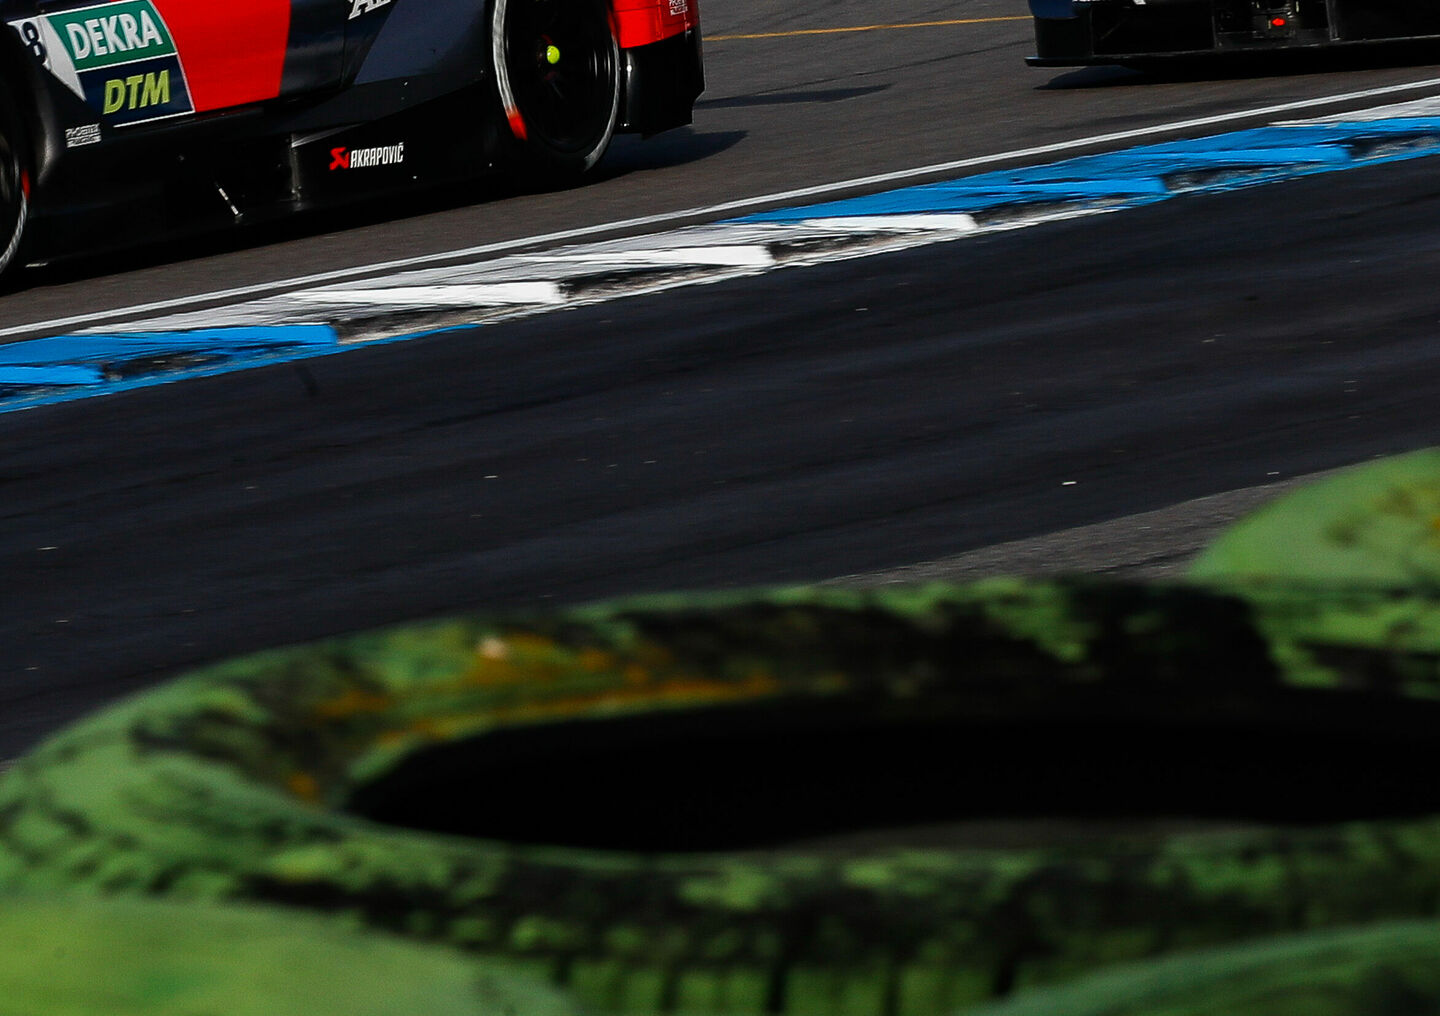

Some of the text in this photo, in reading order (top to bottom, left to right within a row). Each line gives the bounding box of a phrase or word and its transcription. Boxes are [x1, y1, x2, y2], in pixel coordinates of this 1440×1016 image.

[65, 10, 163, 60] DEKRA
[103, 69, 170, 115] DTM
[350, 140, 404, 168] AKRAPOVIČ
